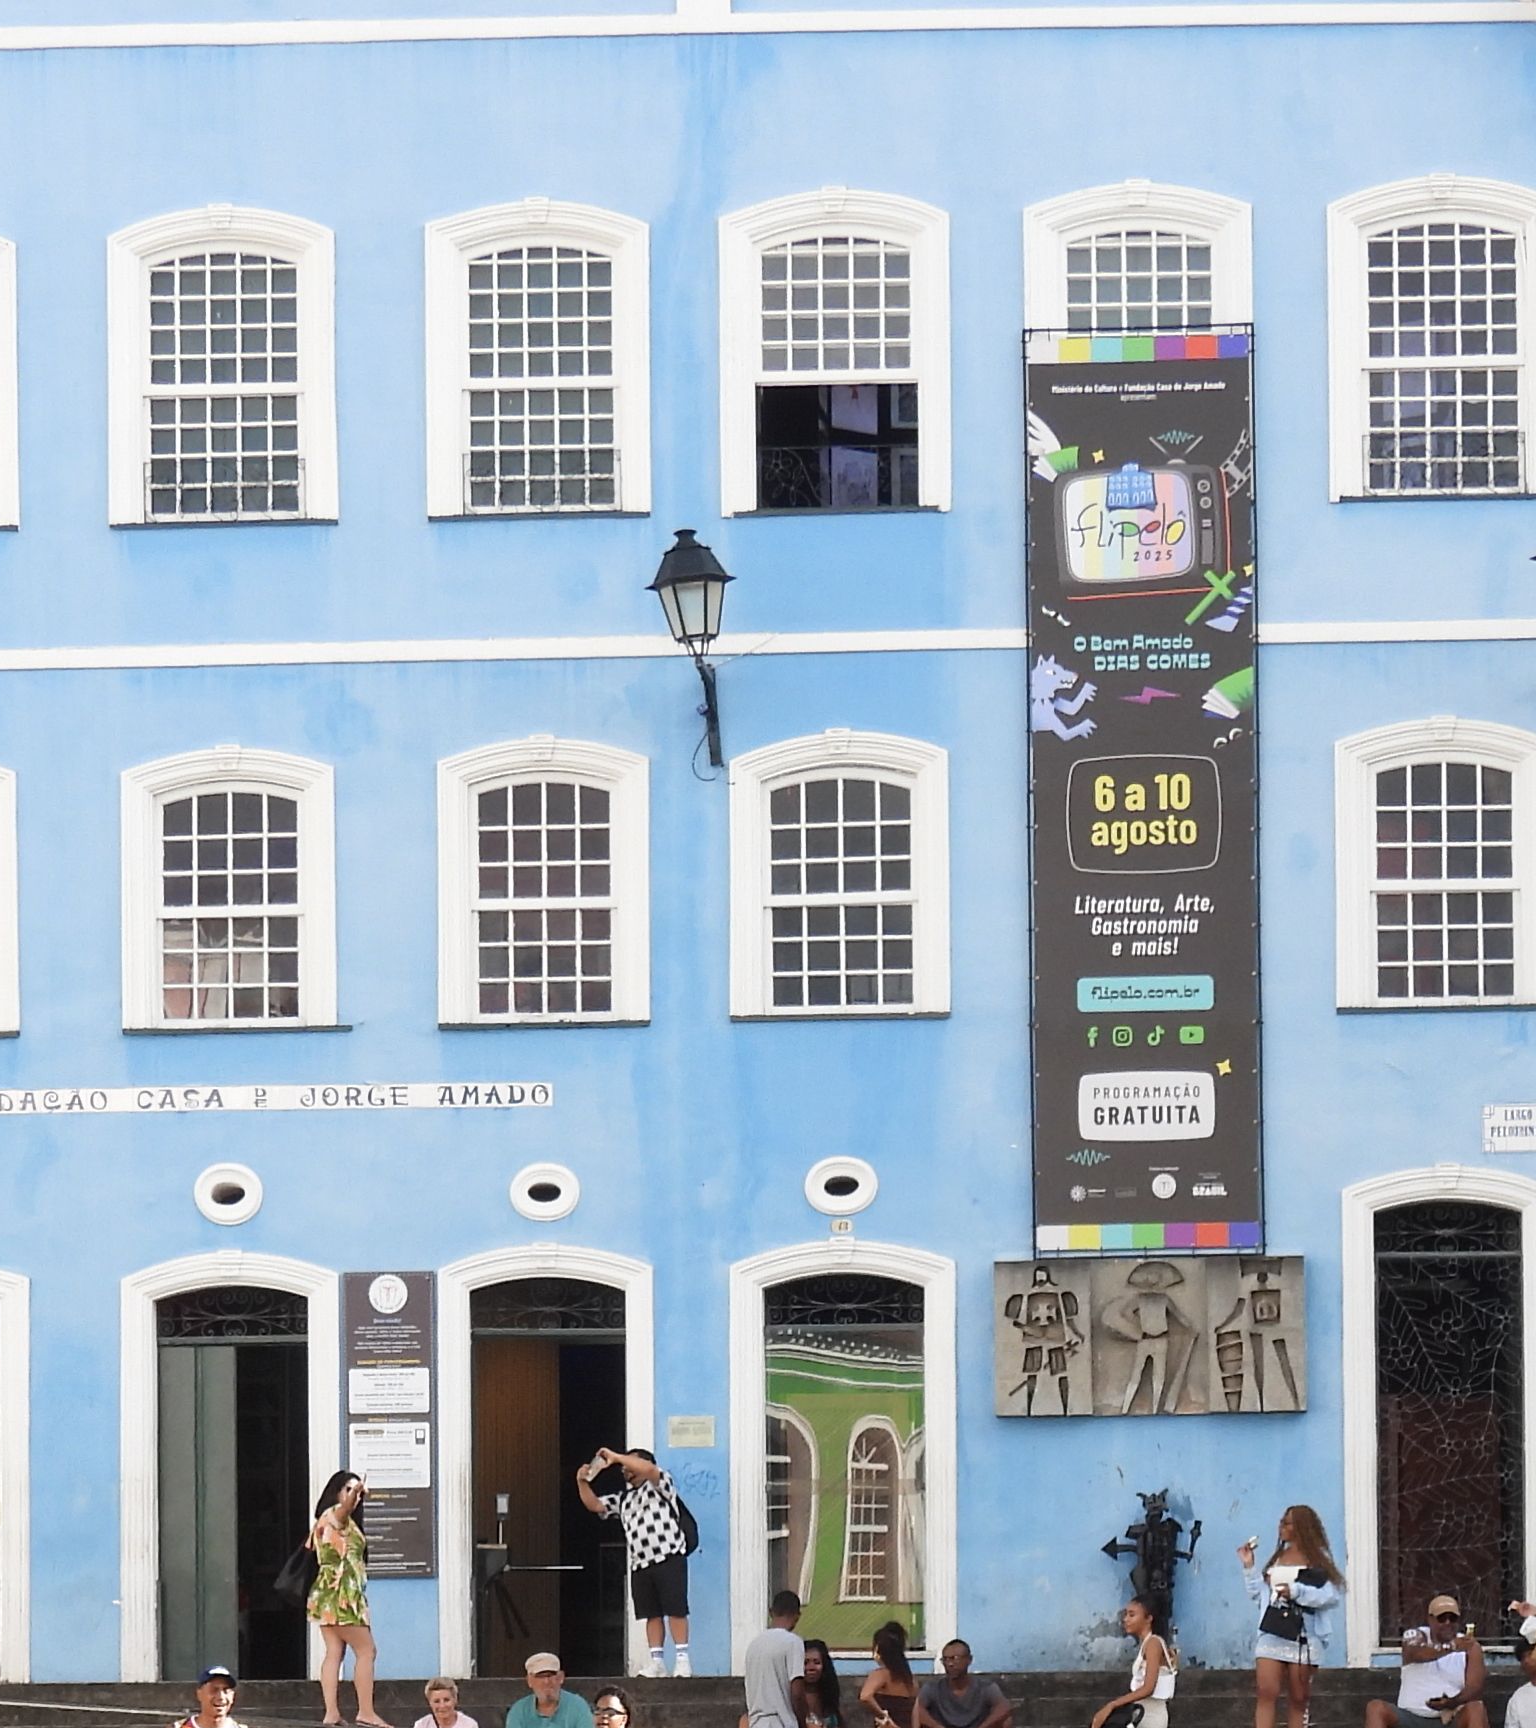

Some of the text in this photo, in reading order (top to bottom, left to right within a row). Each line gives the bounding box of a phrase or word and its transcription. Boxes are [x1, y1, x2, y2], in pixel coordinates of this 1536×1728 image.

[1132, 549, 1175, 562] 2025
[1074, 636, 1087, 652] O
[1132, 634, 1193, 650] Amado
[1094, 653, 1211, 672] DIAS GOMES
[1094, 774, 1192, 812] 6 a 10
[1090, 814, 1198, 855] agosto
[1074, 894, 1215, 915] Literatura, Arte,
[1091, 916, 1199, 936] Gastronomia
[1111, 936, 1179, 958] e mais!
[1090, 984, 1200, 1002] flipelo.com.br
[137, 1087, 224, 1110] CASA
[300, 1084, 410, 1108] JORGE
[438, 1084, 550, 1106] AMADO
[1093, 1083, 1201, 1101] PROGRAMAÇÃO
[1093, 1104, 1202, 1126] GRATUITA
[1504, 1109, 1533, 1121] LARGO
